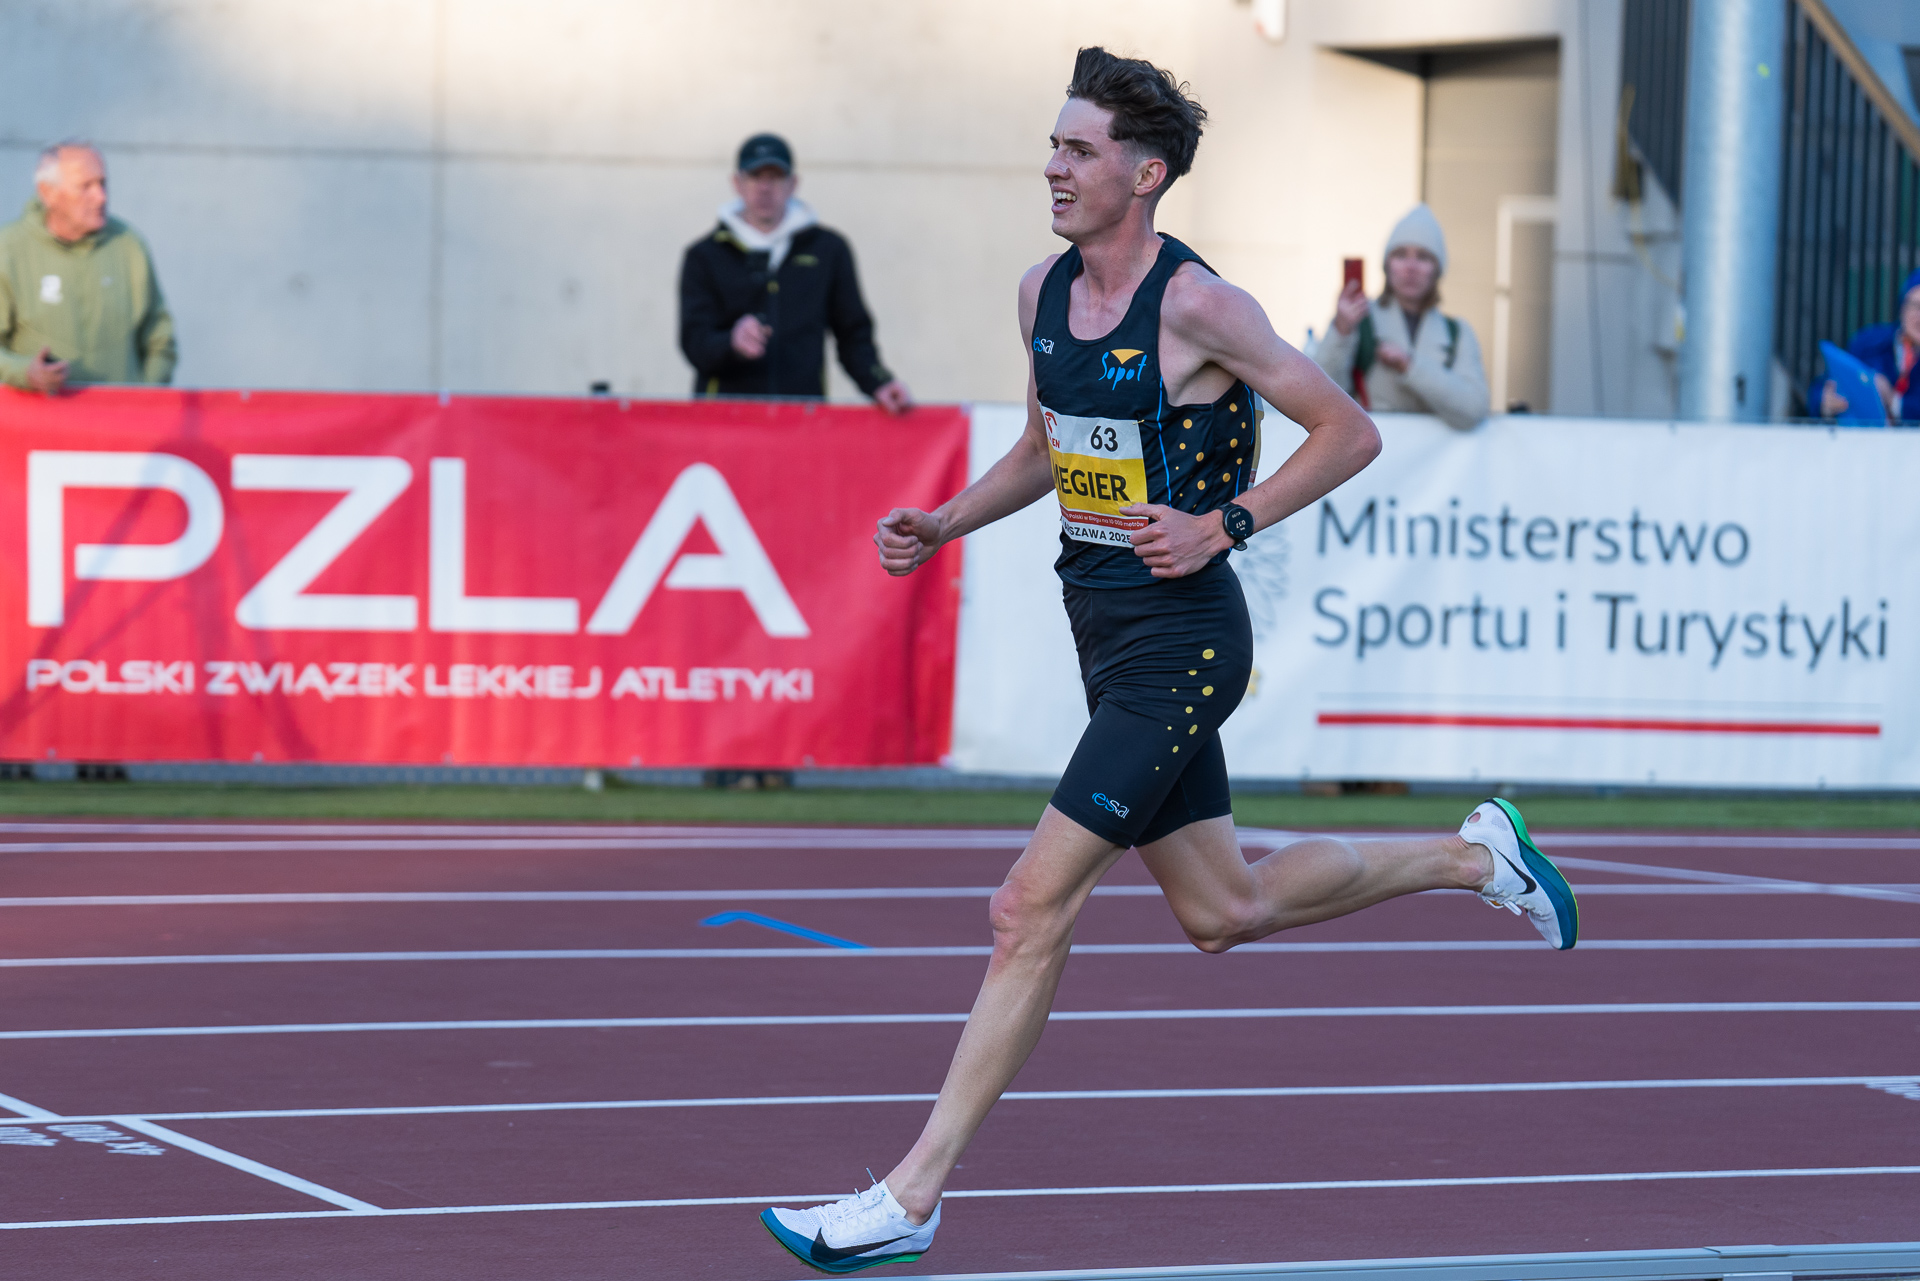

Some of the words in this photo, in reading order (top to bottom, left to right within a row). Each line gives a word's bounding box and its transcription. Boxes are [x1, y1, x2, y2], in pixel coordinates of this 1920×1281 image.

[1098, 352, 1147, 390] Sopot
[1090, 425, 1118, 452] 63
[26, 450, 811, 638] PZLA
[1316, 497, 1750, 567] Ministerstwo
[1313, 587, 1529, 660] Sportu
[1555, 592, 1567, 650] i
[1593, 594, 1888, 669] Turystyki
[26, 659, 195, 694] POLSKI
[204, 661, 417, 702] ZWIĄZEK
[424, 663, 602, 699] LEKKIEJ
[610, 666, 814, 701] ATLETYKI
